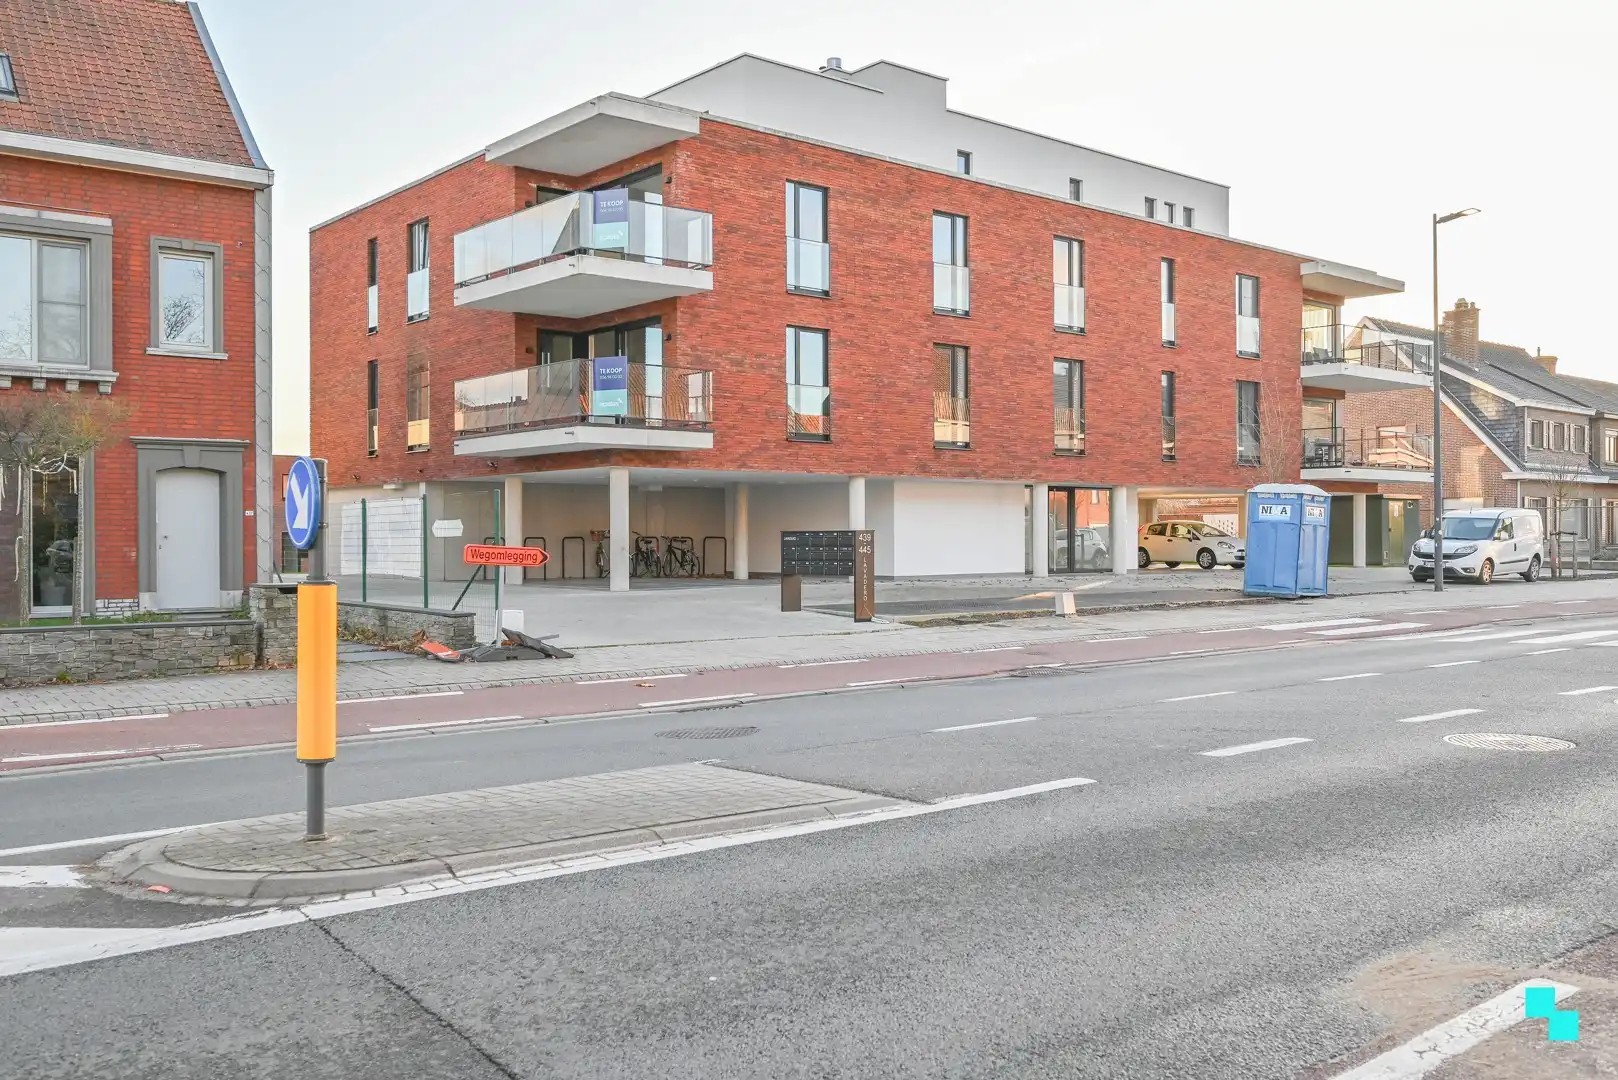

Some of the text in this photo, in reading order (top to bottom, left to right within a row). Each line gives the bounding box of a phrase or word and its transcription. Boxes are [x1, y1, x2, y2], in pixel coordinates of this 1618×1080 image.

[607, 199, 624, 207] KOOP
[1261, 505, 1288, 515] NIA
[858, 533, 871, 541] 439
[858, 545, 871, 554] 445
[470, 548, 538, 564] Wegomlegging
